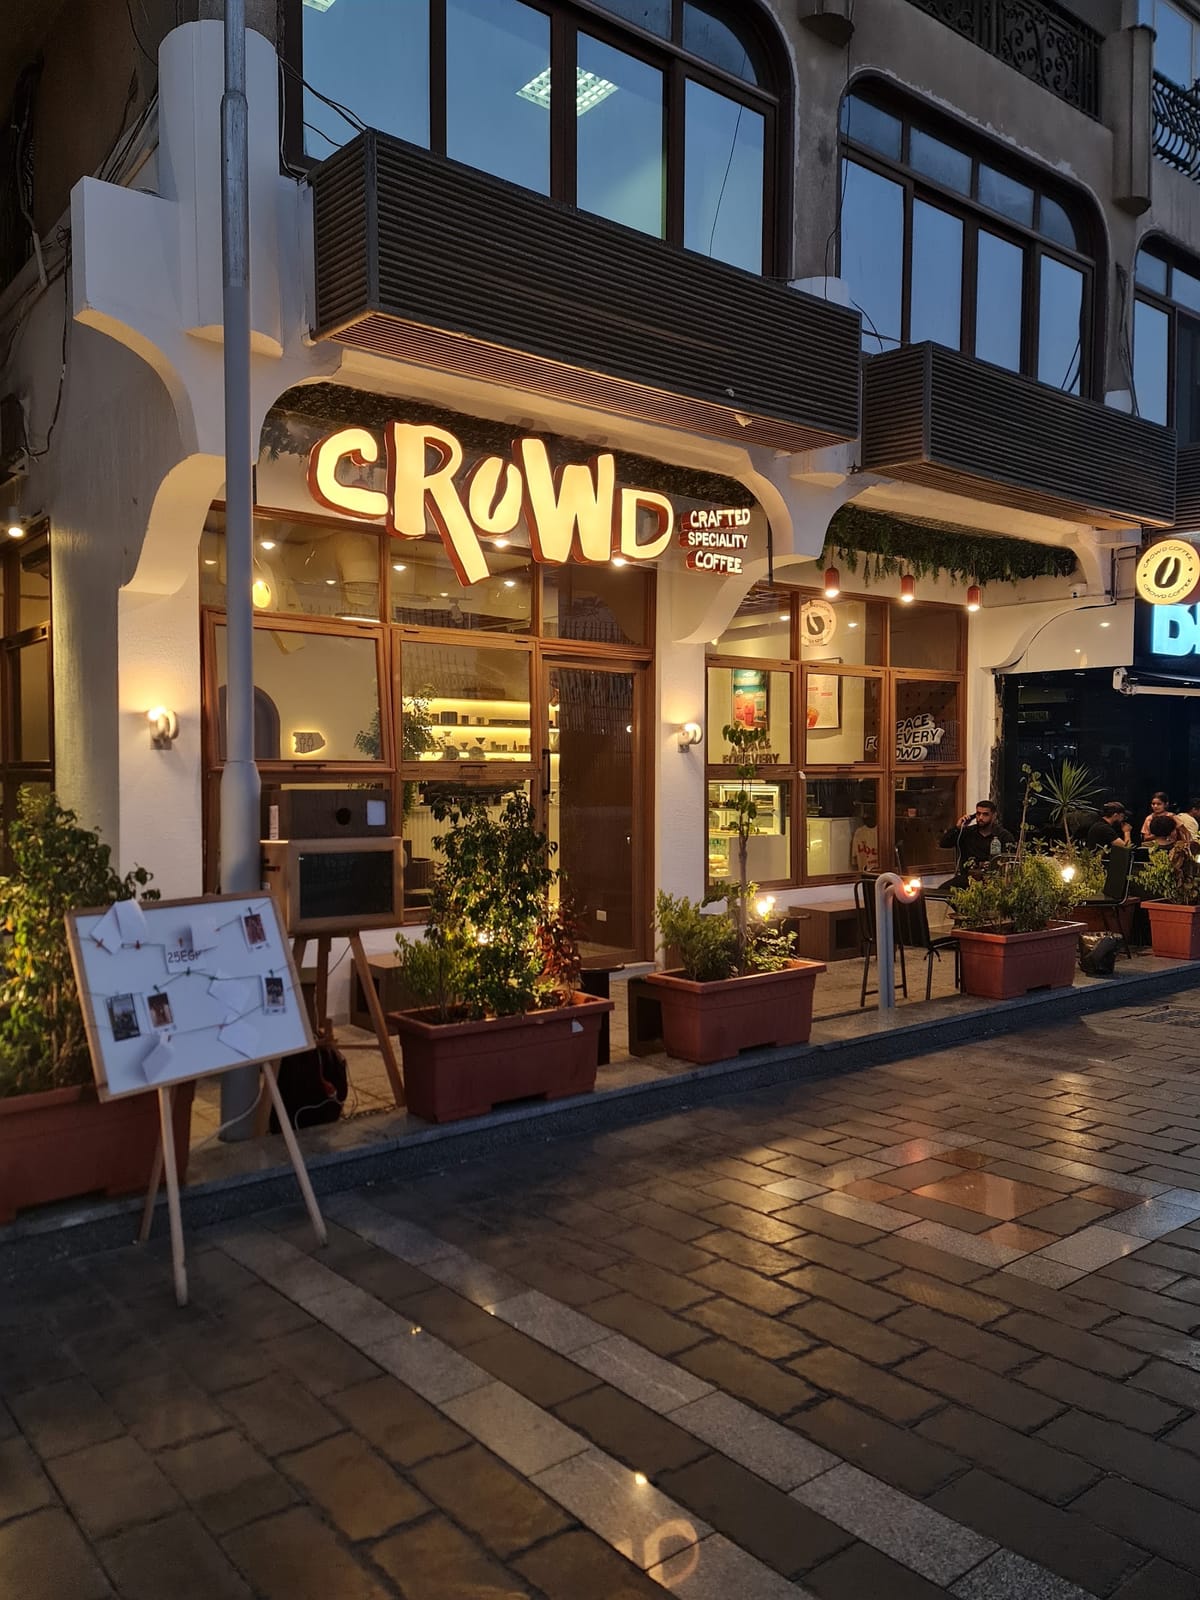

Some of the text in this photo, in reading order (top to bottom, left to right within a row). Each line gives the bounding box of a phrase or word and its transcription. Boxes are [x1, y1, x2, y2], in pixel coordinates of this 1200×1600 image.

[309, 421, 674, 585] CROWD
[688, 508, 751, 529] CRAFTED
[686, 531, 748, 549] SPECIALITY
[693, 550, 743, 574] COFFEE
[1143, 545, 1194, 569] CROWD COFFEE
[1143, 577, 1193, 599] CROWD COFFEE
[1152, 602, 1200, 656] D
[896, 713, 932, 732] PACE
[896, 729, 940, 746] EVERY
